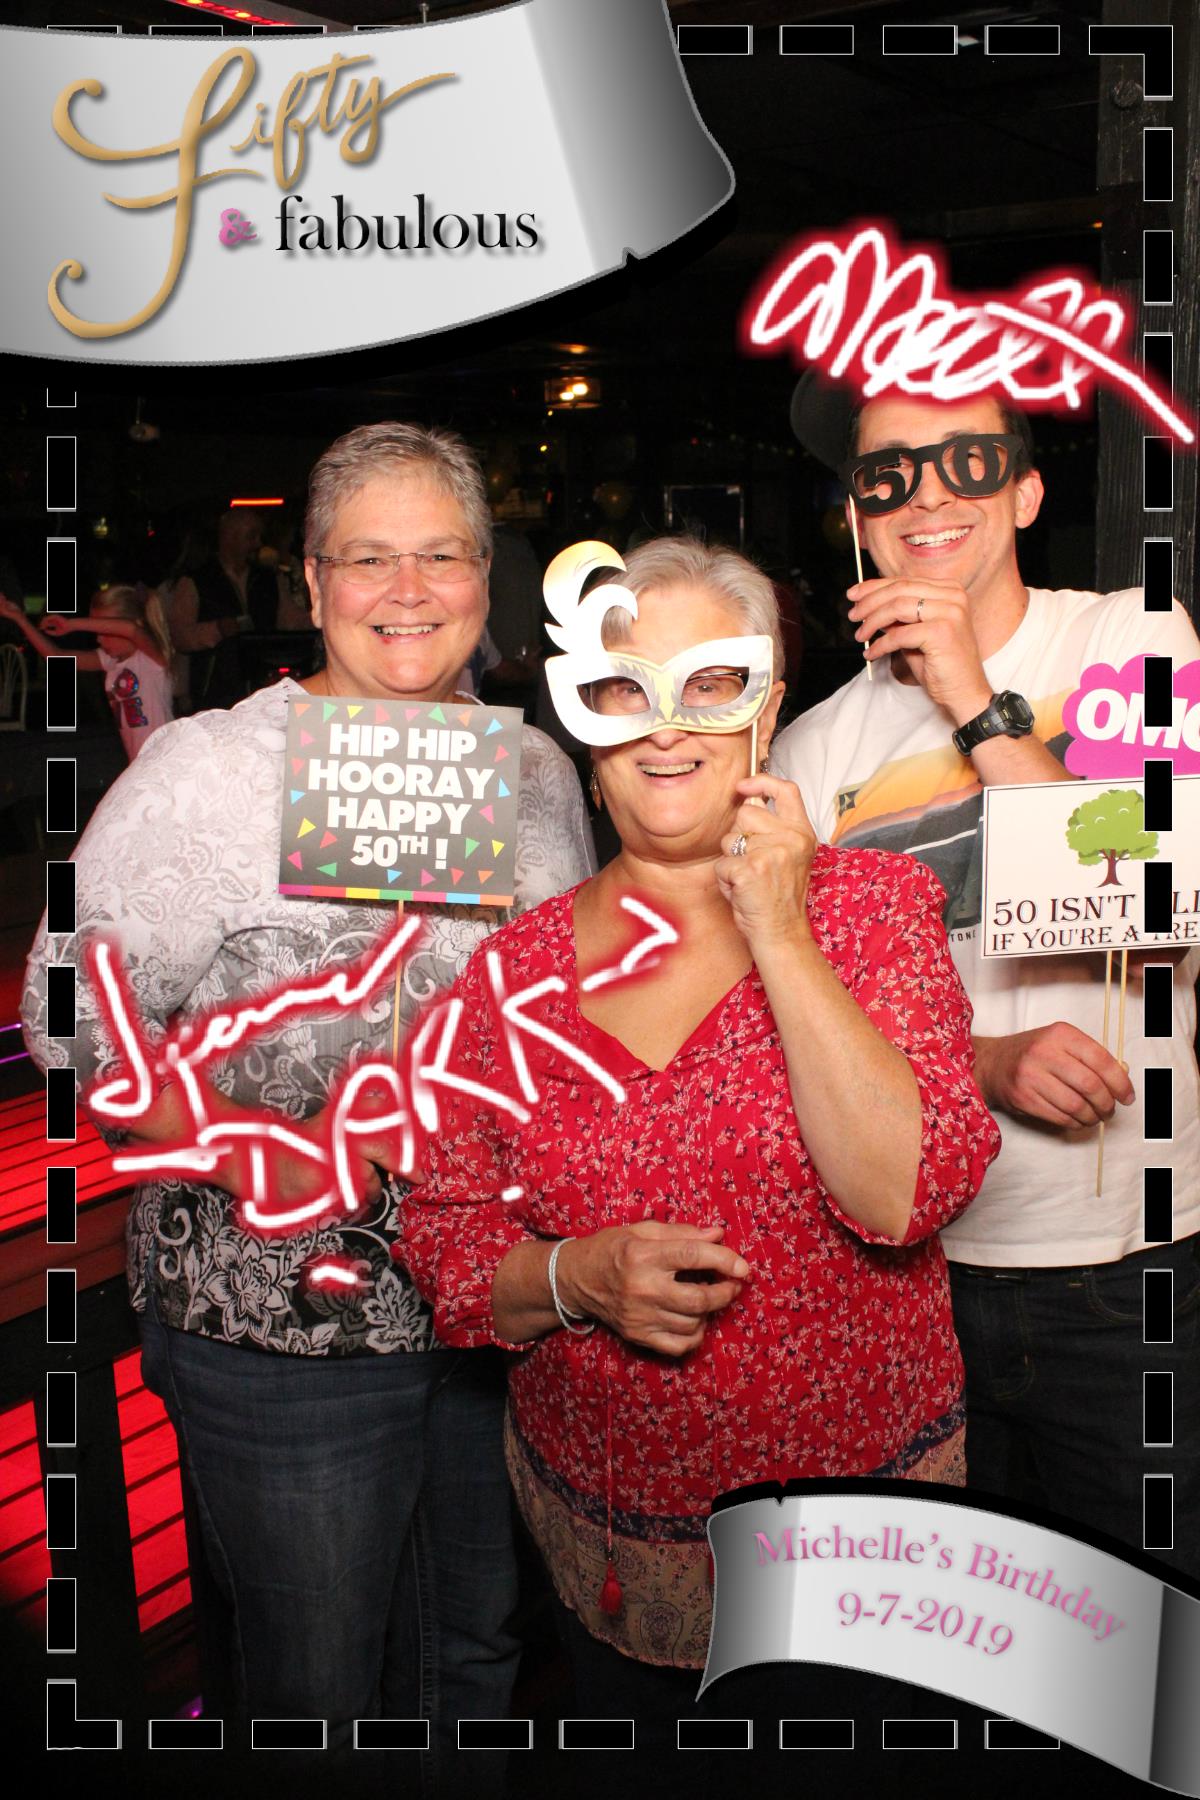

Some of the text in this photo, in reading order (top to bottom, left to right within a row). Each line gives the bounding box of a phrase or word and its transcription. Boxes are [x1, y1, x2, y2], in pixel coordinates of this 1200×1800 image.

[854, 437, 1003, 513] 50
[328, 722, 478, 762] HIP HIP
[307, 758, 496, 800] HOORAY
[326, 796, 473, 835] HAPPY
[993, 893, 1136, 926] 50 ISN'T
[950, 929, 976, 942] TONE
[991, 932, 1015, 951] IF
[1023, 925, 1113, 950] YOU'RE
[1121, 924, 1140, 943] A
